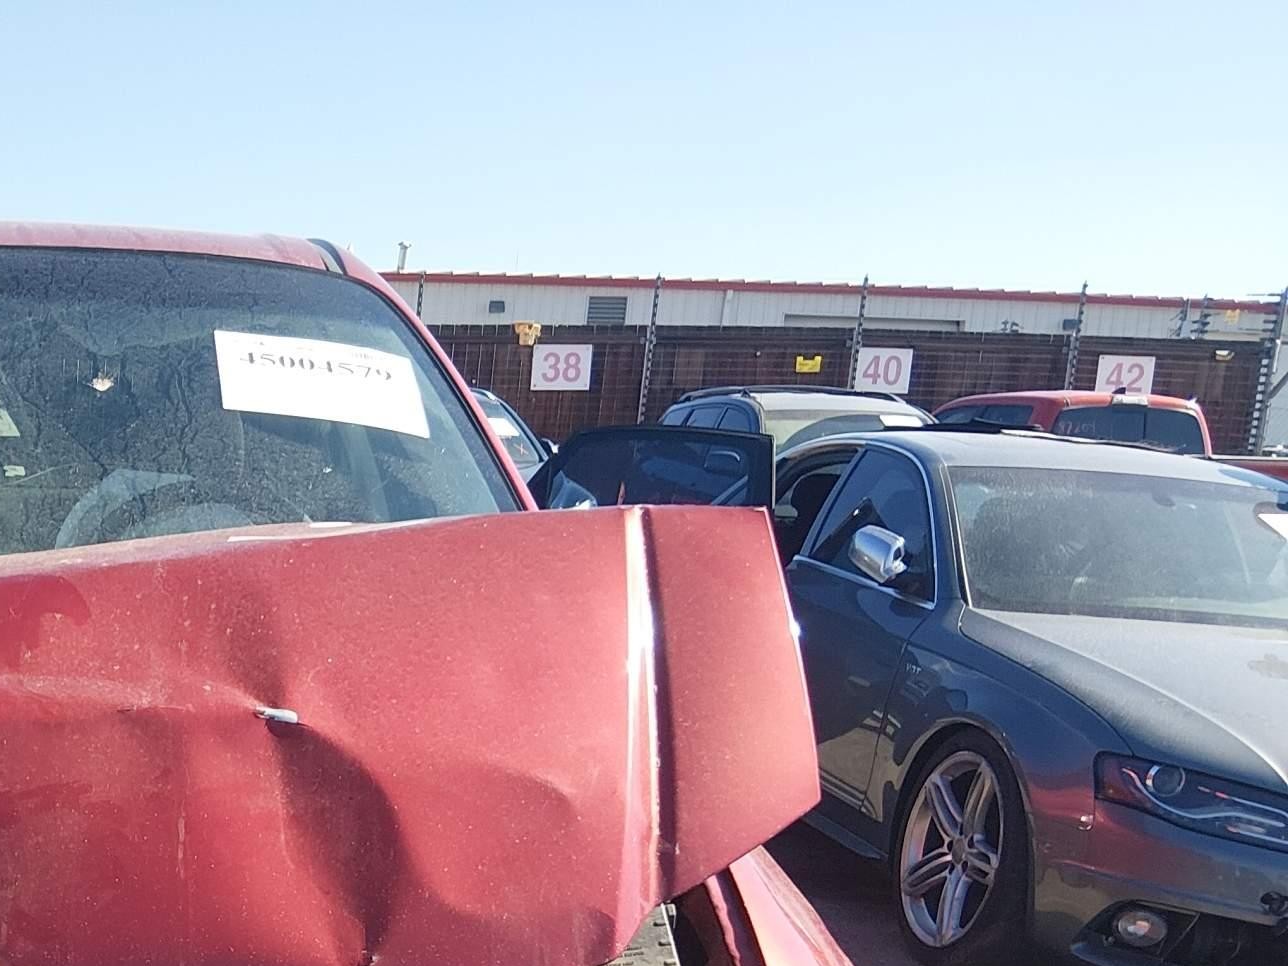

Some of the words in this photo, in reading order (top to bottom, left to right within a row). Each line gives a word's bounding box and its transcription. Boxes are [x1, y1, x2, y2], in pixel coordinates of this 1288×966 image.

[239, 351, 393, 381] 45004579
[541, 351, 582, 383] 38
[862, 354, 903, 386] 40
[1104, 361, 1145, 393] 42
